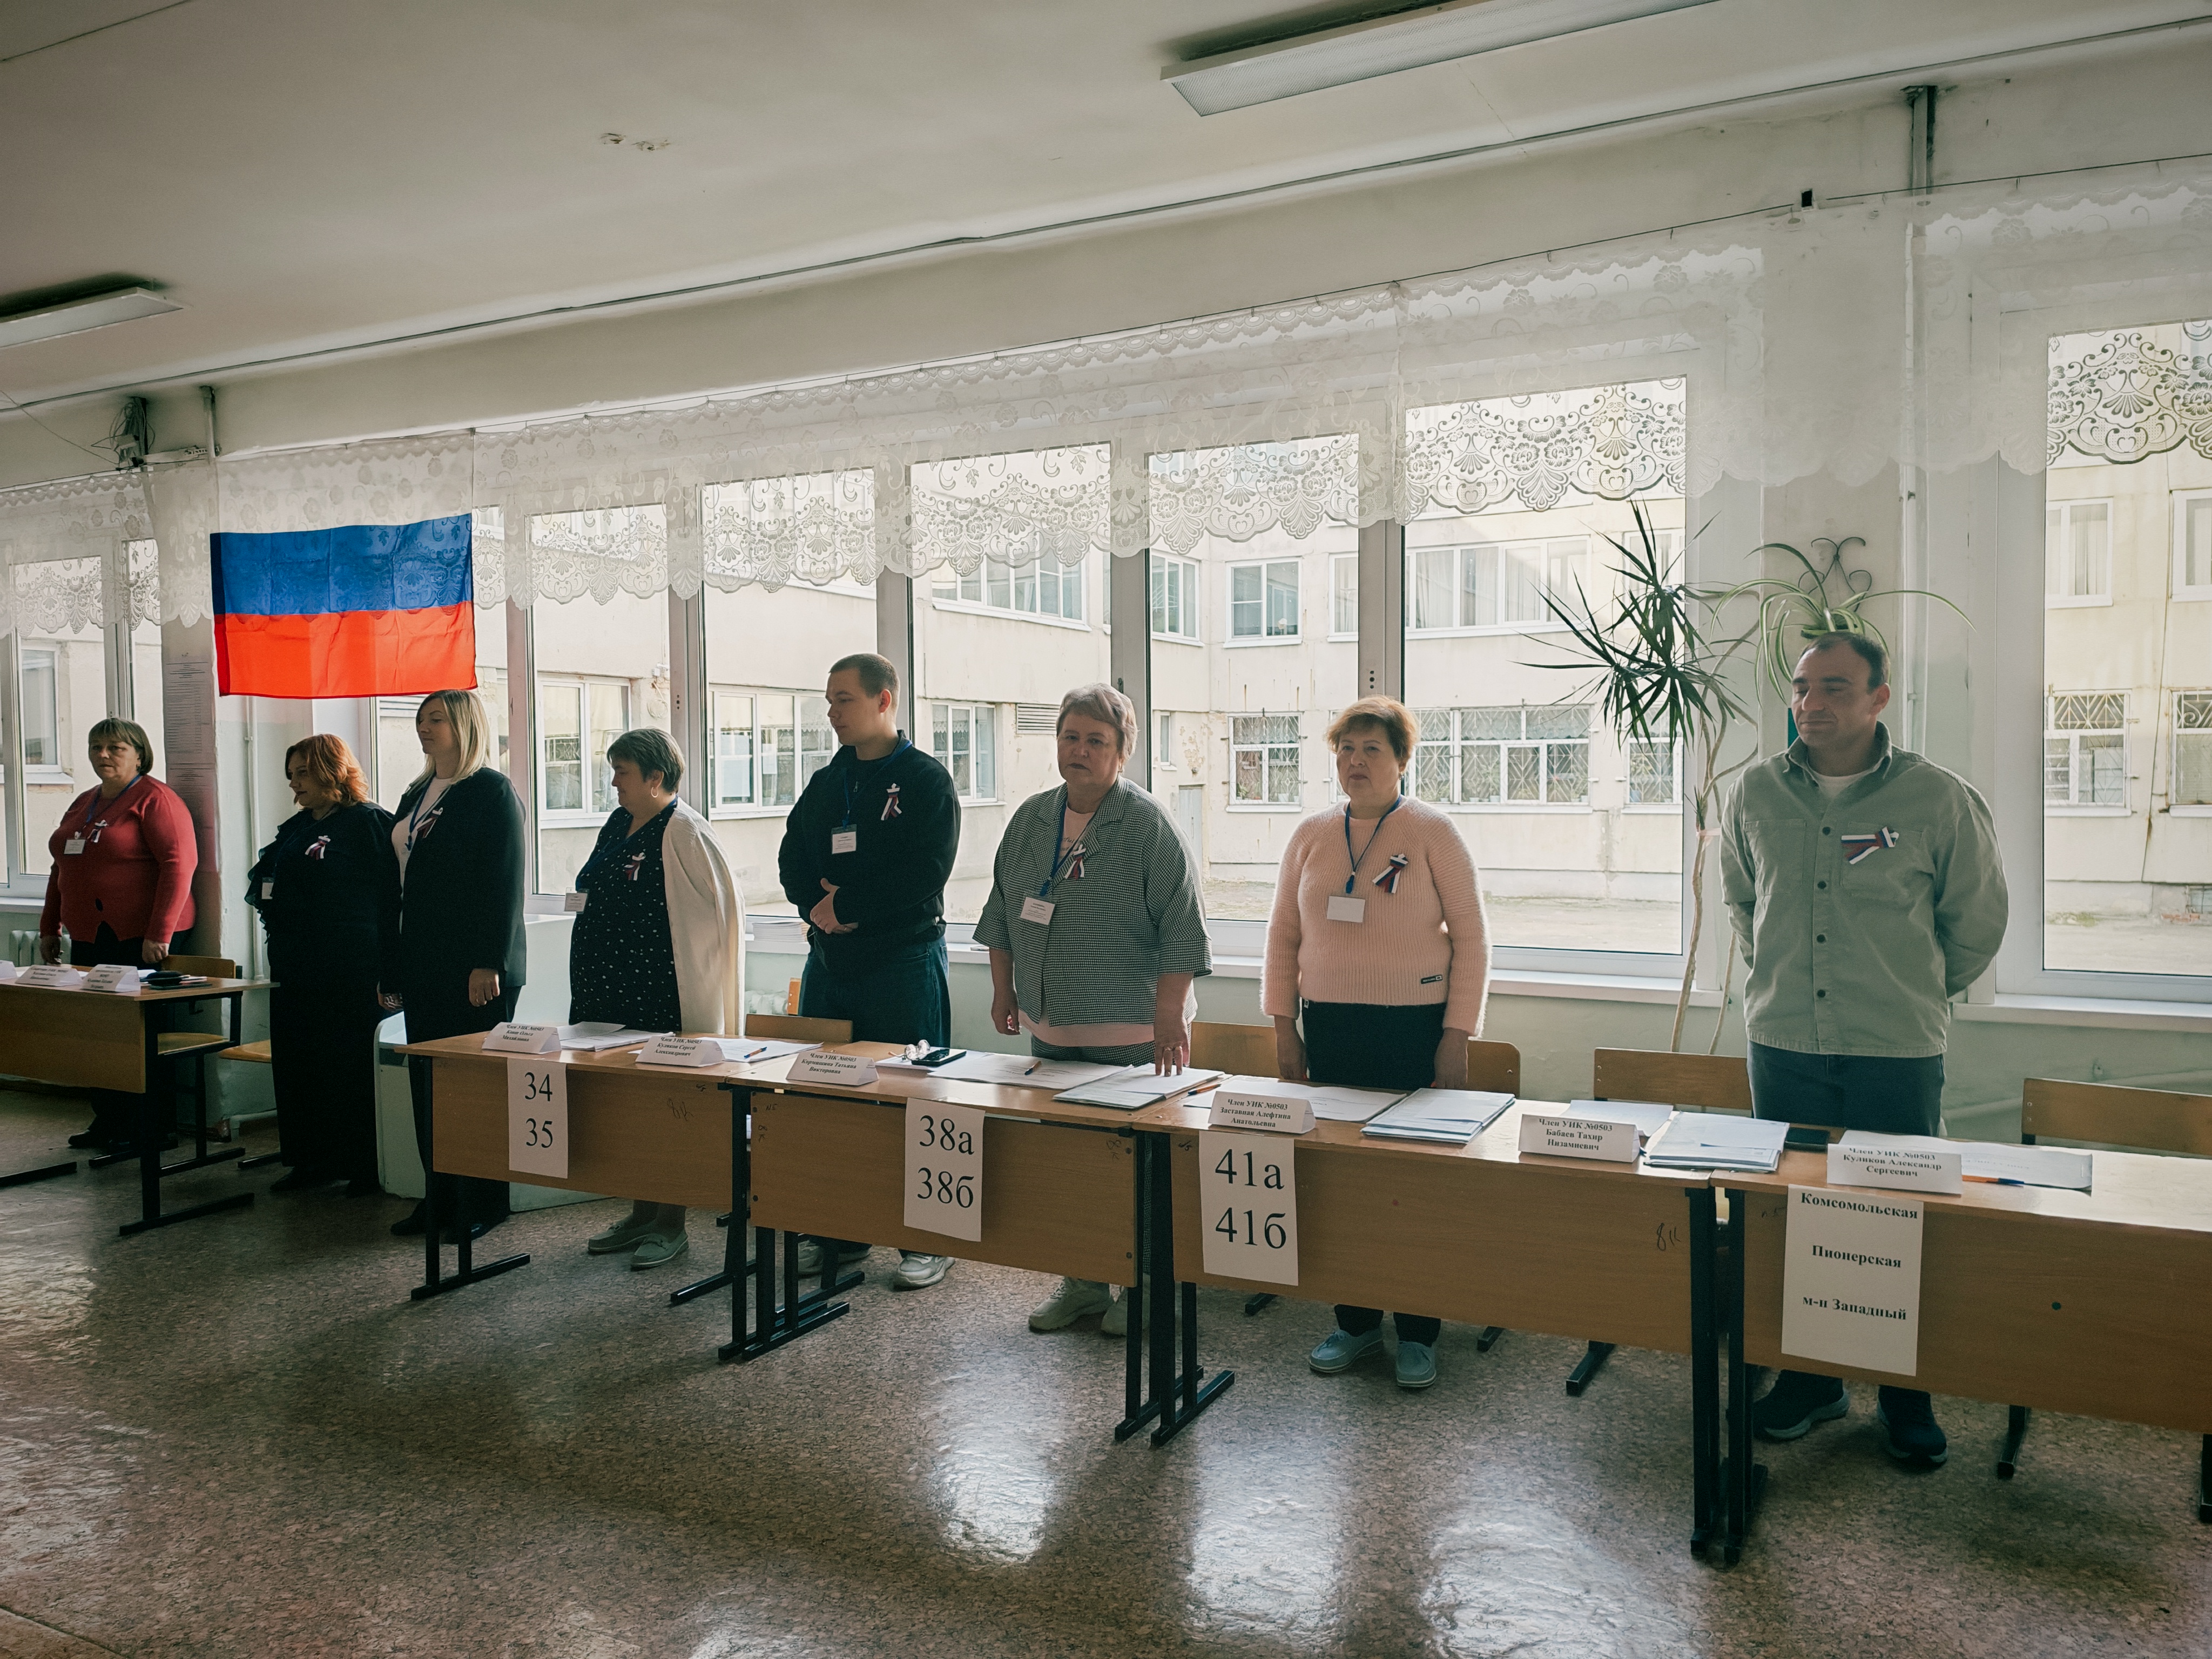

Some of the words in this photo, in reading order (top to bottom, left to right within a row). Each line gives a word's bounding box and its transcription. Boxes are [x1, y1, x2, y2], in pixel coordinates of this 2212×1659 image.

[655, 1049, 691, 1057] Александрович
[809, 1066, 841, 1074] Викторовна
[524, 1071, 553, 1102] 34
[1228, 1098, 1245, 1107] Член
[1264, 1102, 1288, 1110] №0503
[1220, 1107, 1255, 1116] Заставная
[1256, 1111, 1291, 1120] Алефтина
[1230, 1117, 1276, 1128] Анатольевна
[1539, 1118, 1560, 1127] Член
[1562, 1120, 1583, 1129] УИК
[1584, 1123, 1613, 1132] №0503
[525, 1118, 553, 1149] 35
[919, 1115, 975, 1155] 38а
[1546, 1129, 1575, 1138] Бабаев
[1577, 1131, 1603, 1142] Тахир
[1547, 1138, 1600, 1151] Низамиевич
[1843, 1154, 1886, 1165] Куликов
[1889, 1159, 1942, 1171] Александр
[1902, 1152, 1936, 1161] №0503
[1215, 1149, 1285, 1190] 41а
[1866, 1165, 1918, 1177] Сергеевич
[917, 1167, 974, 1209] 38б
[1800, 1192, 1918, 1219] Комсомольская
[1215, 1207, 1286, 1249] 41б
[1812, 1244, 1901, 1269] Пионерская
[1802, 1296, 1828, 1309] м-н
[1832, 1298, 1907, 1320] Западный
